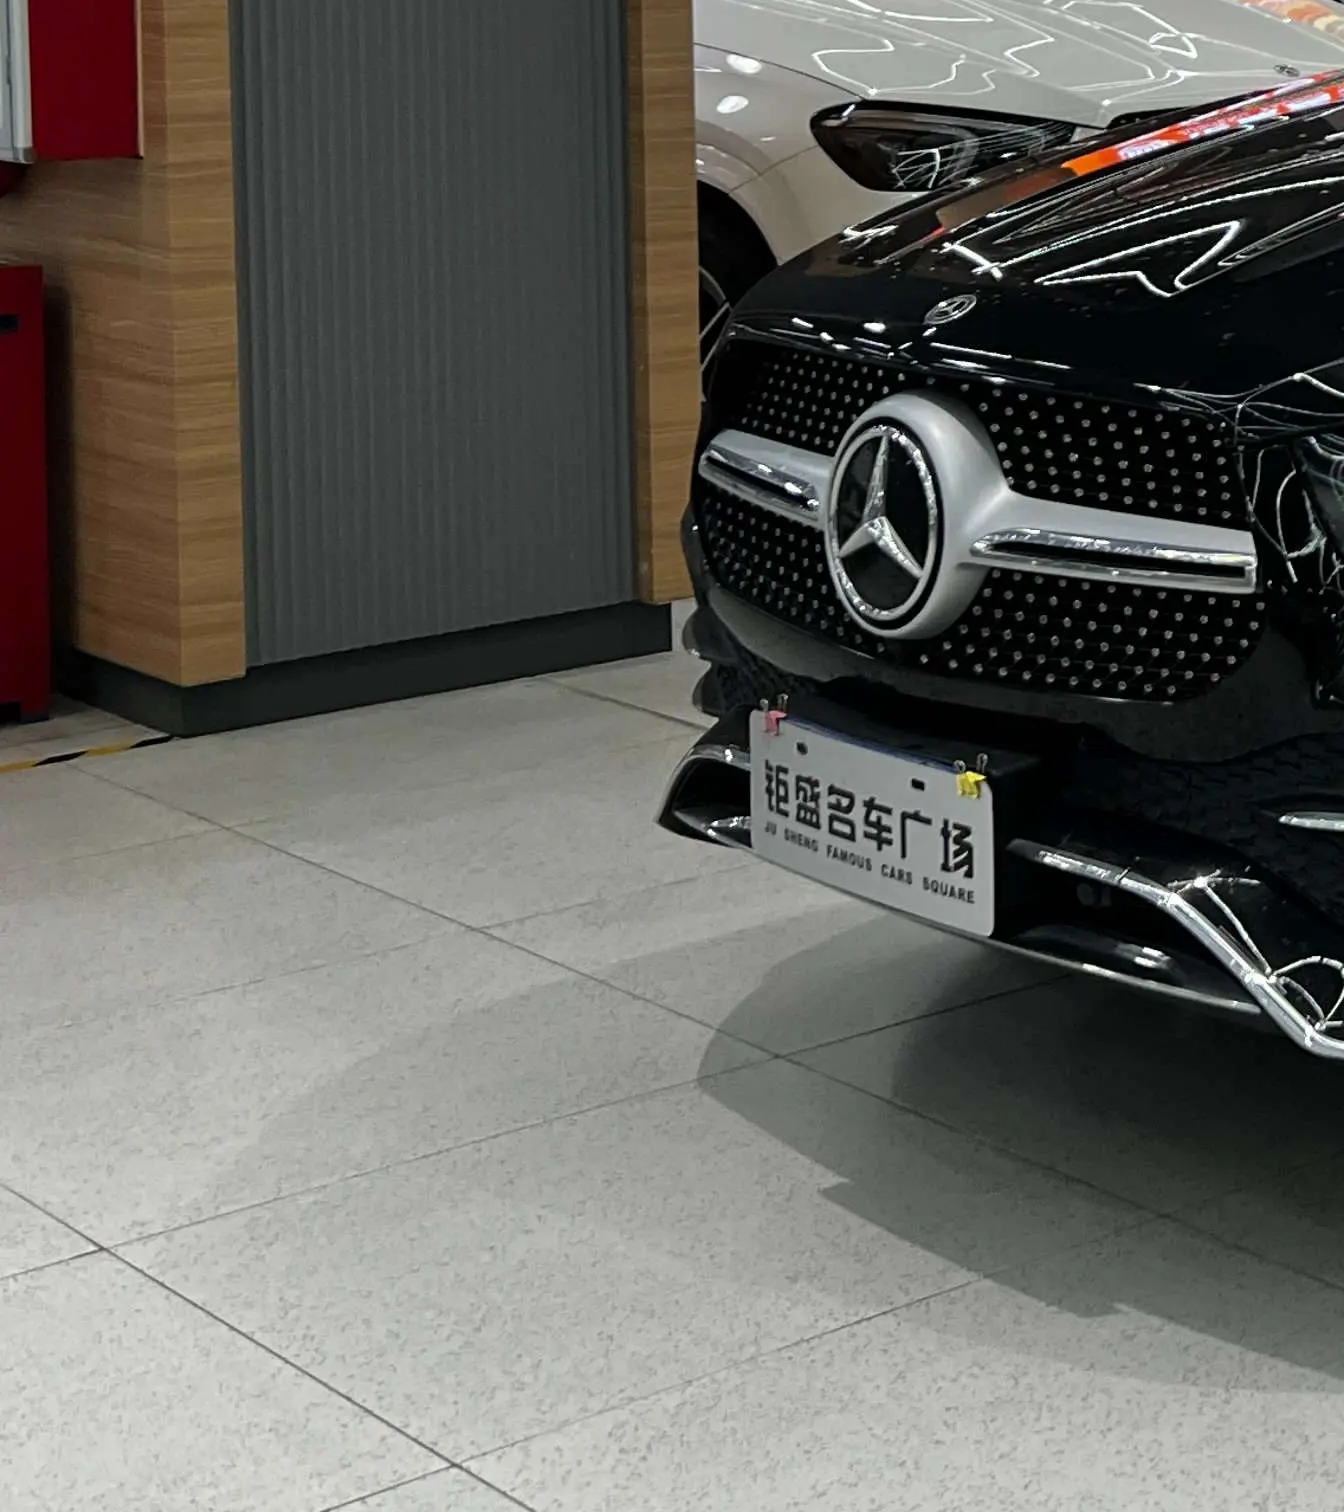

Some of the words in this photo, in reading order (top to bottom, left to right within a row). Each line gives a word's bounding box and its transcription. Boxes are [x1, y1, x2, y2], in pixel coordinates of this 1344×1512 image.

[764, 821, 778, 836] JU
[784, 828, 819, 853] SHENG
[826, 844, 873, 873] FAMOUS
[880, 863, 914, 886] CARS
[922, 876, 976, 905] SQUARE
[765, 759, 975, 879] 钜盛名车广场
